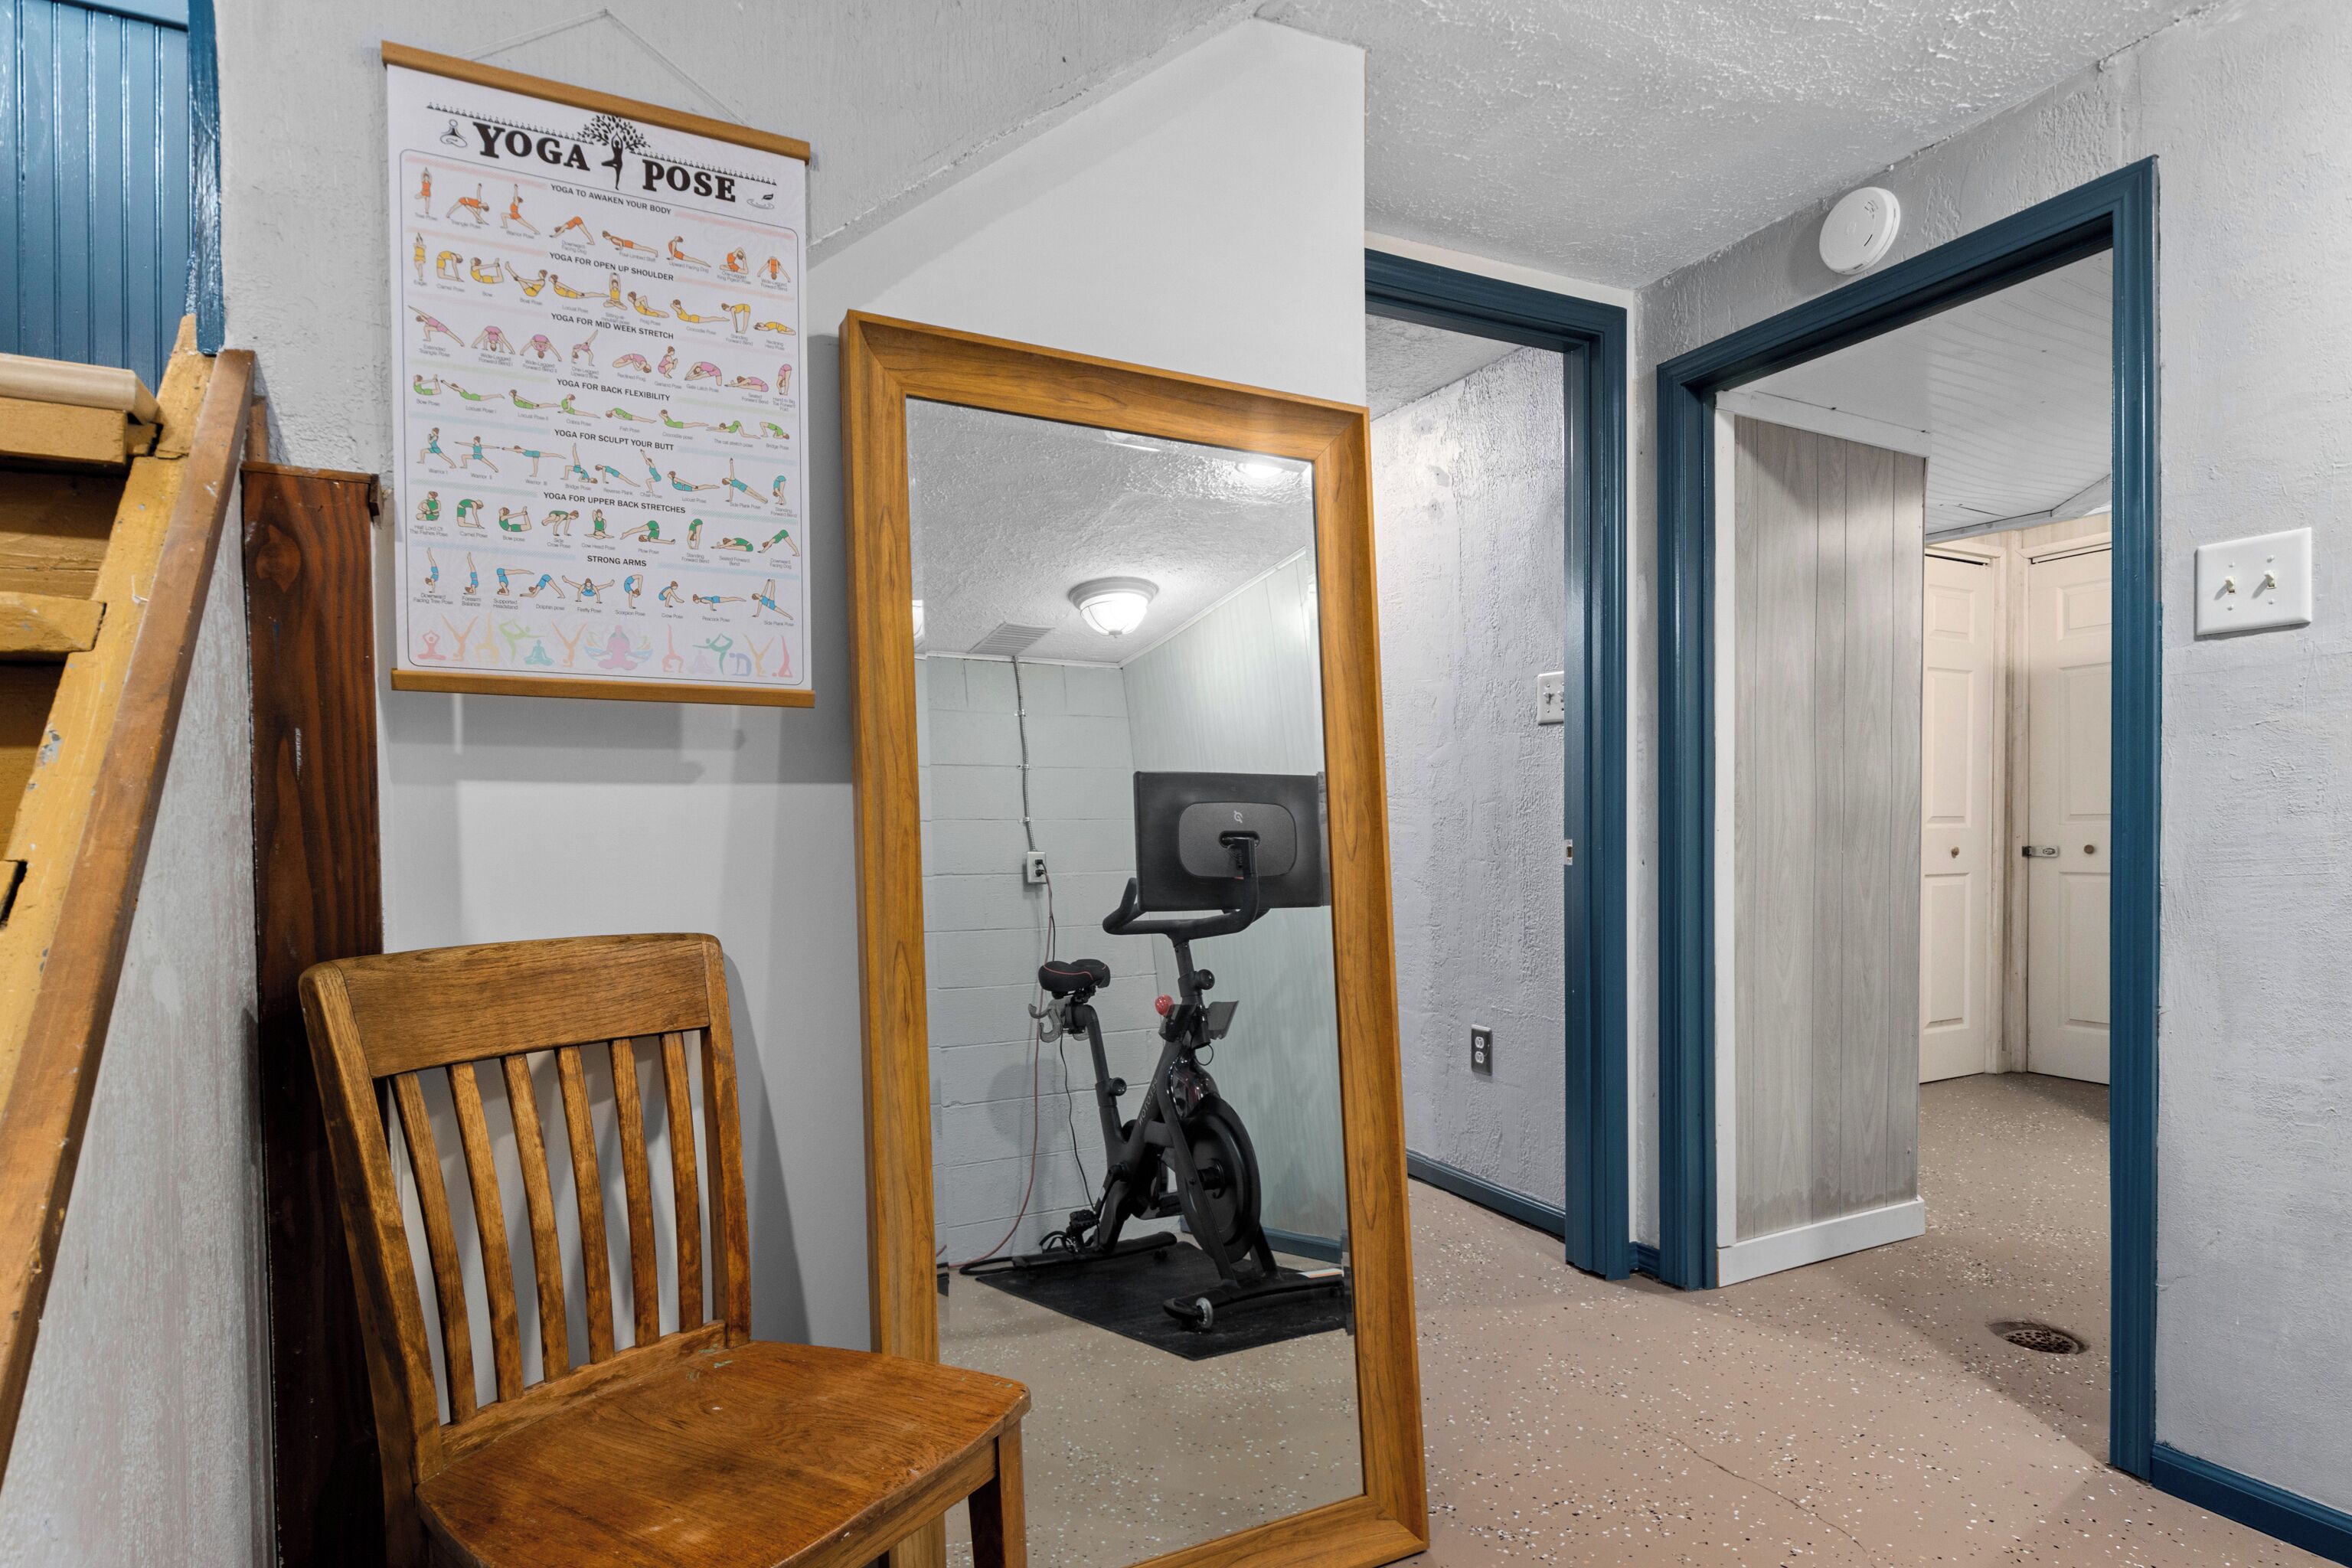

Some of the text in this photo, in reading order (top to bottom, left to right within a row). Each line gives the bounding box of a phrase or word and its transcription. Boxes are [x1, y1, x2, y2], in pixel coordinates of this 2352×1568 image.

[472, 122, 735, 202] YOGA POSE
[550, 184, 573, 194] YOGA
[589, 191, 623, 204] AWAKEN
[626, 199, 647, 209] YOUR
[650, 204, 671, 214] BODY
[550, 252, 571, 262] YOGA
[575, 256, 590, 266] FOR
[593, 260, 616, 270] OPEN
[631, 267, 673, 280] SHOULDER
[551, 312, 573, 322] YOGA
[577, 317, 592, 325] FOR
[596, 320, 610, 328] MID
[613, 323, 636, 333] WEEK
[639, 328, 673, 339] STRETCH
[557, 379, 670, 400] YOGA FOR BACK FLEXIBILITY
[554, 429, 577, 438] YOGA
[598, 435, 629, 445] SCULPT
[631, 439, 652, 448] YOUR
[588, 497, 614, 505] UPPER
[617, 500, 639, 508] BACK
[641, 503, 685, 513] STRETCHES
[587, 555, 620, 564] STRONG
